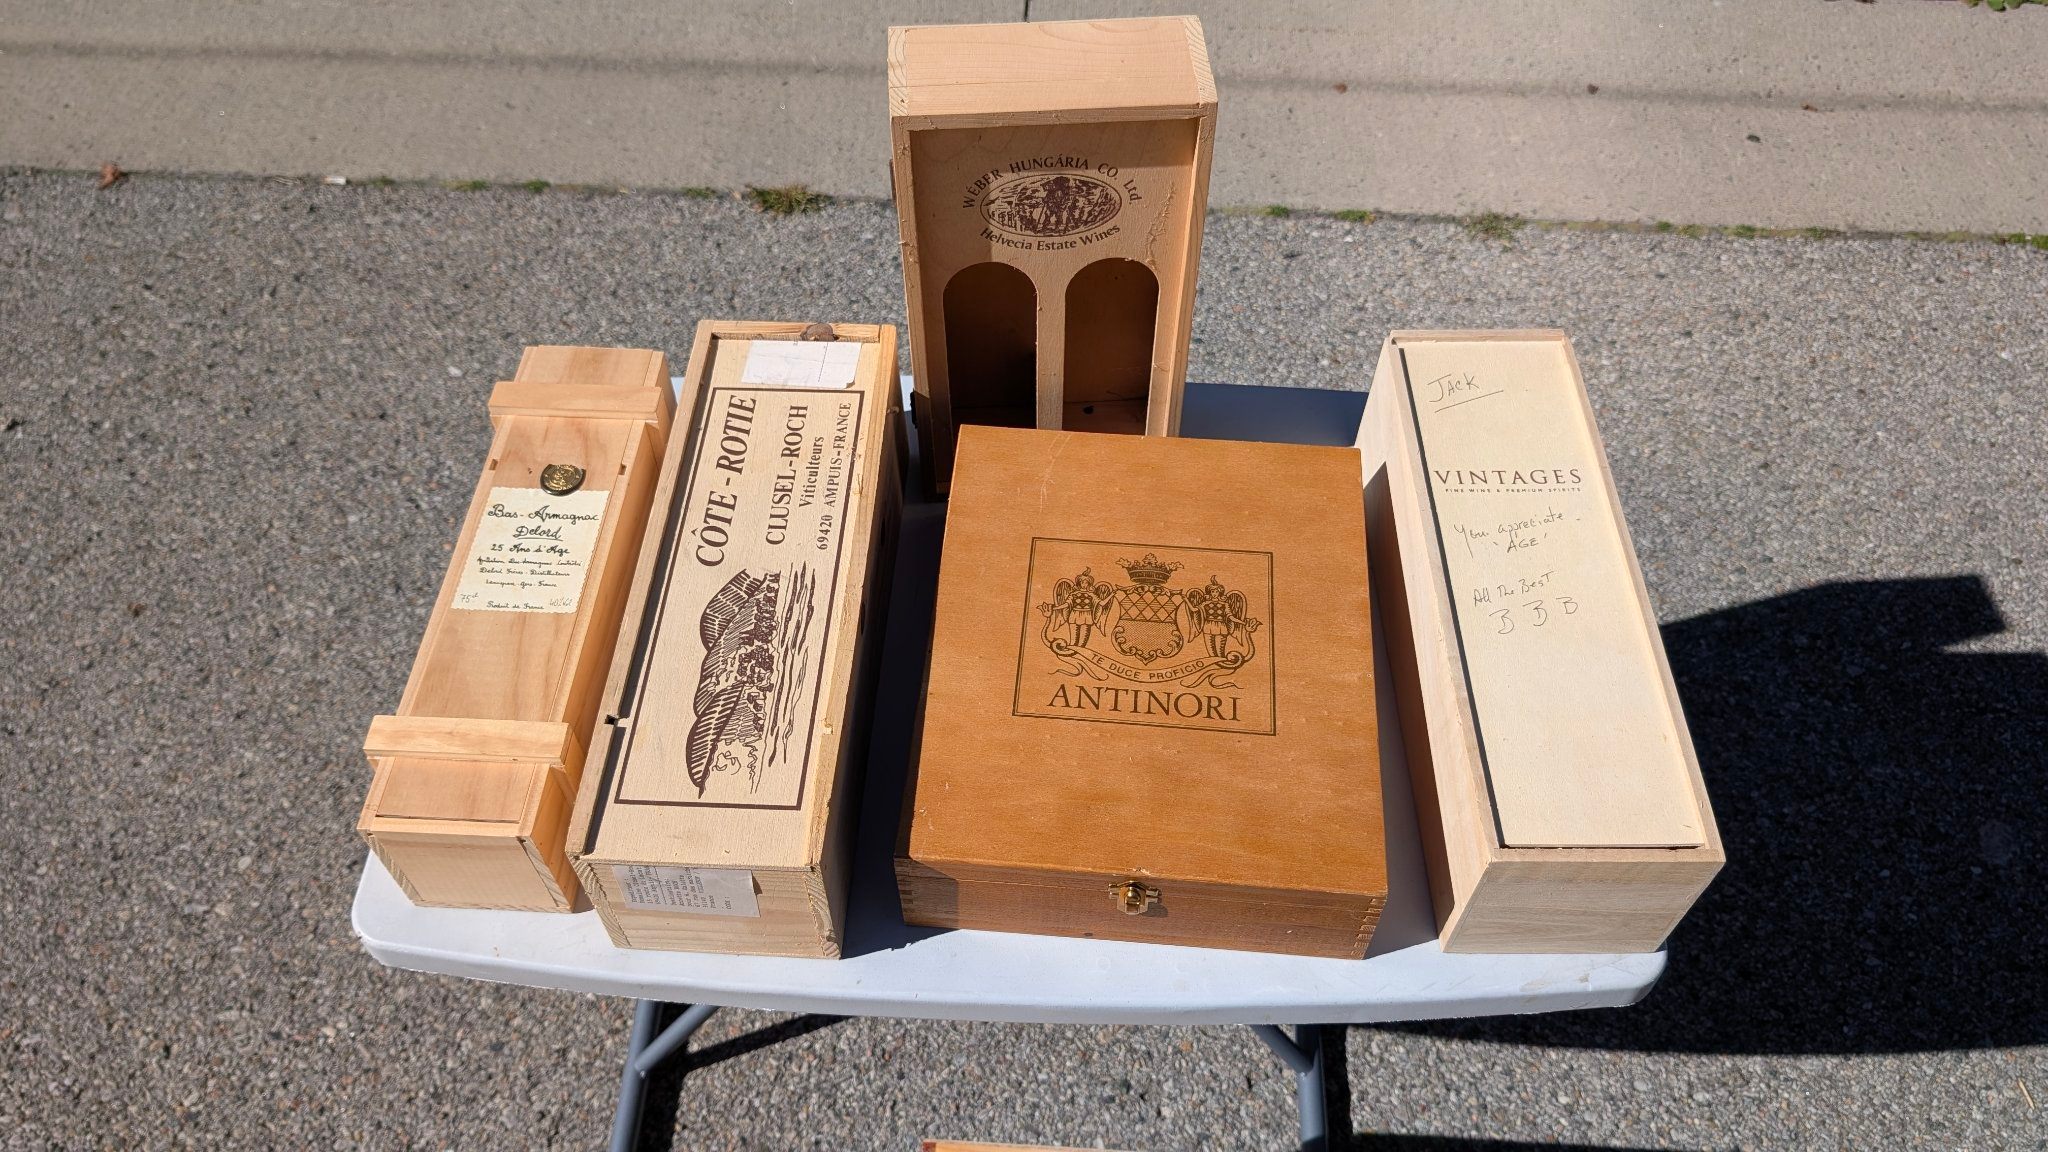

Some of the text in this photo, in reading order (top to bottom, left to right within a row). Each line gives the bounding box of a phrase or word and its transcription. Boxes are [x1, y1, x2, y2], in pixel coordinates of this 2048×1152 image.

[1009, 153, 1089, 174] HUNGÁRIA
[1097, 163, 1119, 181] CO.
[1123, 179, 1142, 205] Ltd.
[980, 224, 1121, 251] Helvecia Estate Wines
[691, 490, 738, 567] CÔTE
[716, 394, 757, 475] ROTIE
[765, 404, 809, 546] CLUSEL-ROCH
[799, 436, 825, 508] Viticulteurs
[817, 402, 852, 550] 69420 AMPUIS-FRANCE
[1433, 468, 1582, 485] VINTAGES
[512, 525, 562, 539] Delord
[1497, 506, 1563, 539] appreciate
[490, 543, 504, 551] 25
[509, 542, 531, 553] Ans
[1090, 652, 1205, 681] TE DUCE PROFICIO
[1047, 683, 1242, 722] ANTINORI
